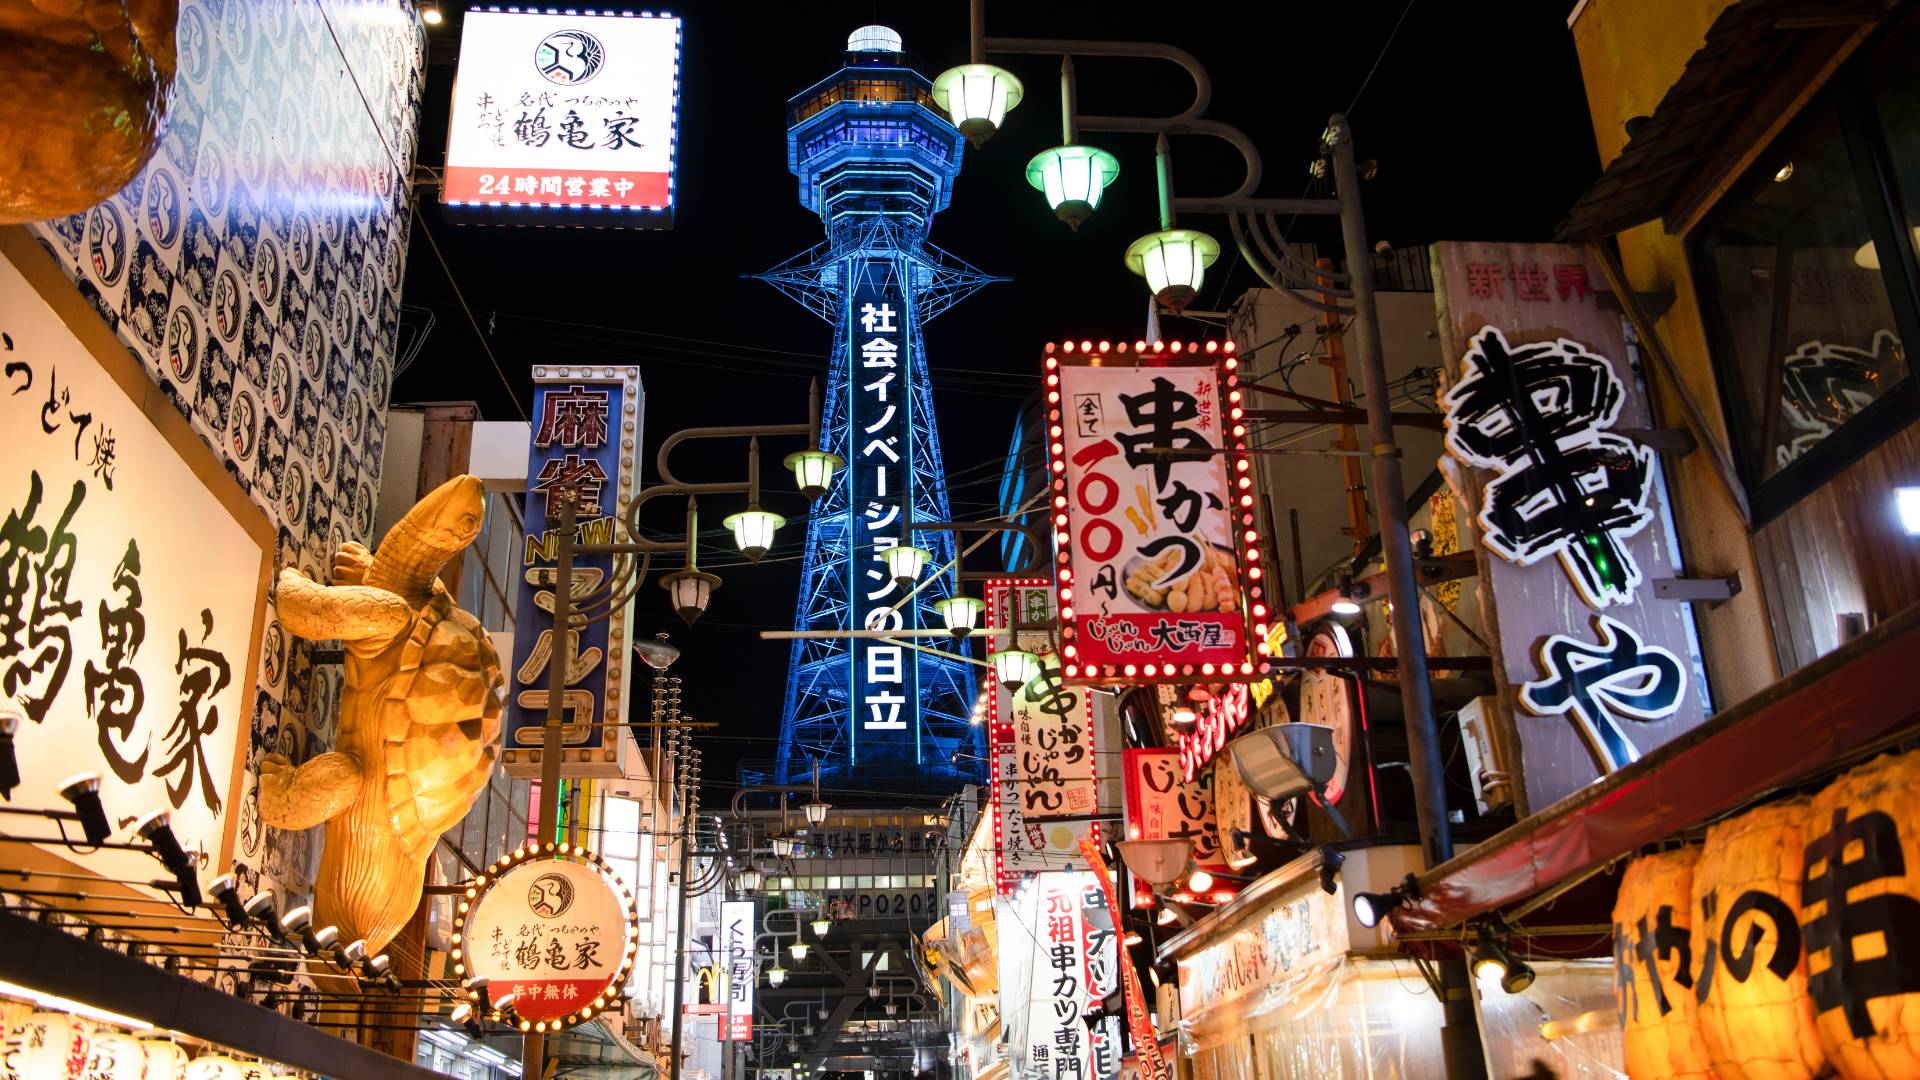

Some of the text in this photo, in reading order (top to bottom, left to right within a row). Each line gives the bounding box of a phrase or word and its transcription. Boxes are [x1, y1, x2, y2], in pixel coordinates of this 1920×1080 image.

[515, 92, 557, 107] 名代
[513, 107, 644, 150] 鶴亀家
[479, 174, 635, 198] 24時間営業中
[1466, 262, 1594, 303] 新世界
[1078, 397, 1098, 433] 全て
[531, 385, 609, 519] 麻雀
[1114, 376, 1224, 587] 串かつ
[861, 302, 907, 731] 社会イノベーションの日立
[0, 469, 231, 820] 鶴亀家
[1149, 618, 1233, 652] 大西屋
[515, 566, 604, 746] マルコ
[1018, 706, 1033, 746] 味自慢
[1008, 809, 1025, 866] たこ焼き
[515, 923, 546, 937] 名代
[515, 937, 603, 971] 鶴亀家
[512, 984, 579, 1001] 年中無休
[1047, 889, 1082, 1080] 元祖串カツ専門
